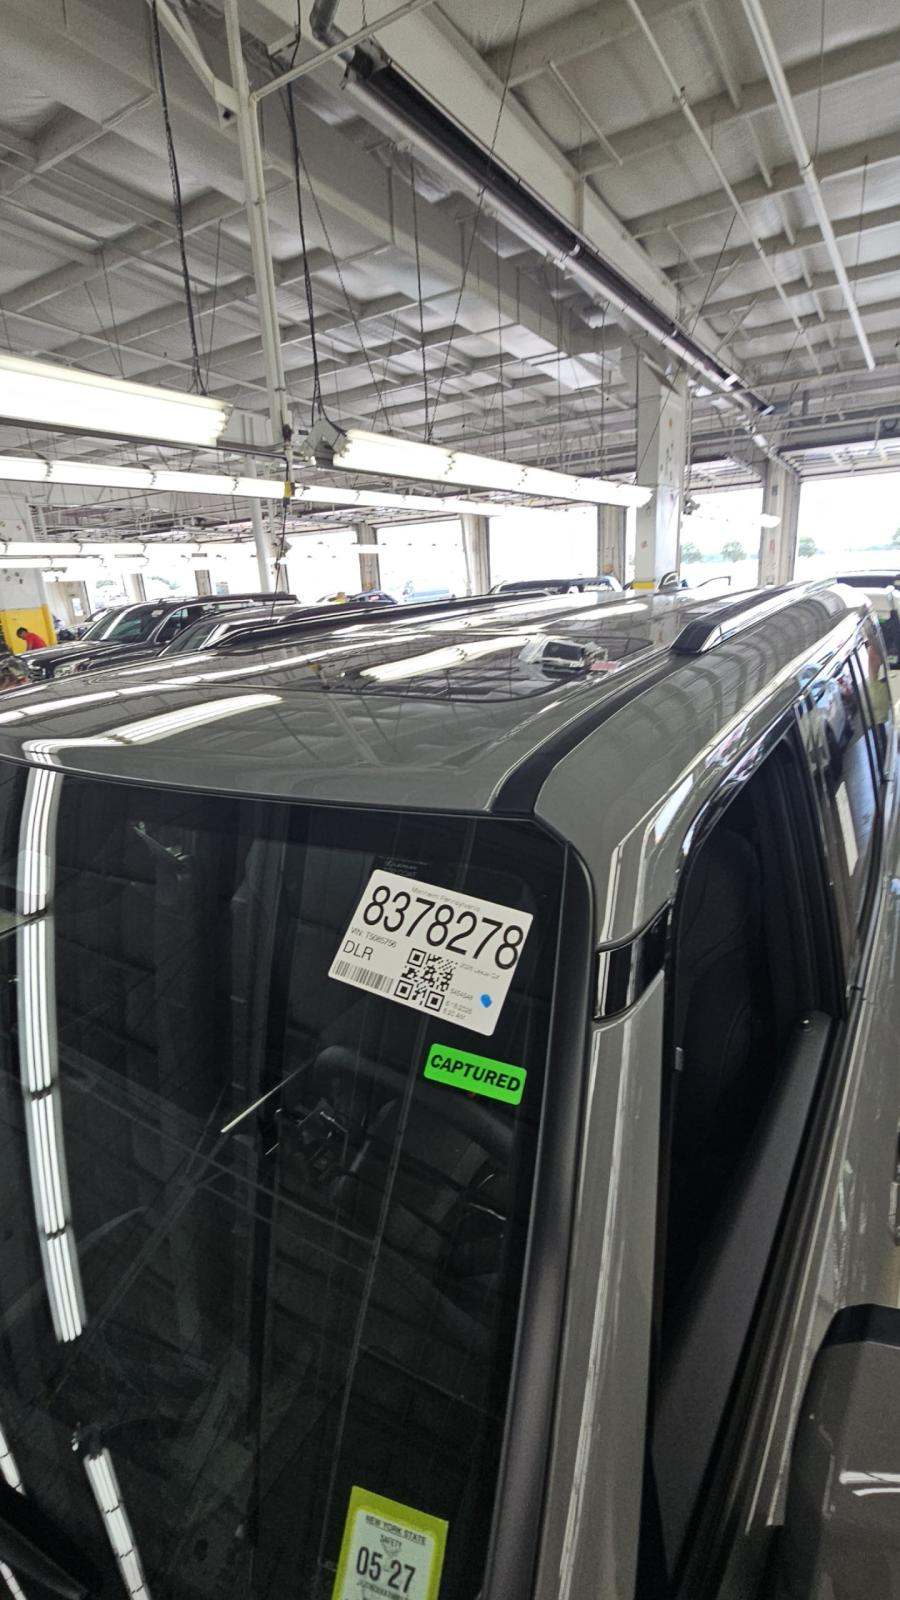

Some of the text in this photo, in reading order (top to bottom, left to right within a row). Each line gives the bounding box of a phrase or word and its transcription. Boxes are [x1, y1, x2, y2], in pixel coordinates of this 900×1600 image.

[363, 885, 524, 970] 8378278
[343, 940, 374, 960] DLR
[431, 1054, 521, 1091] CAPTURED
[365, 1514, 427, 1545] NEW YORK STATE
[356, 1546, 383, 1581] 05
[387, 1559, 416, 1594] 27
